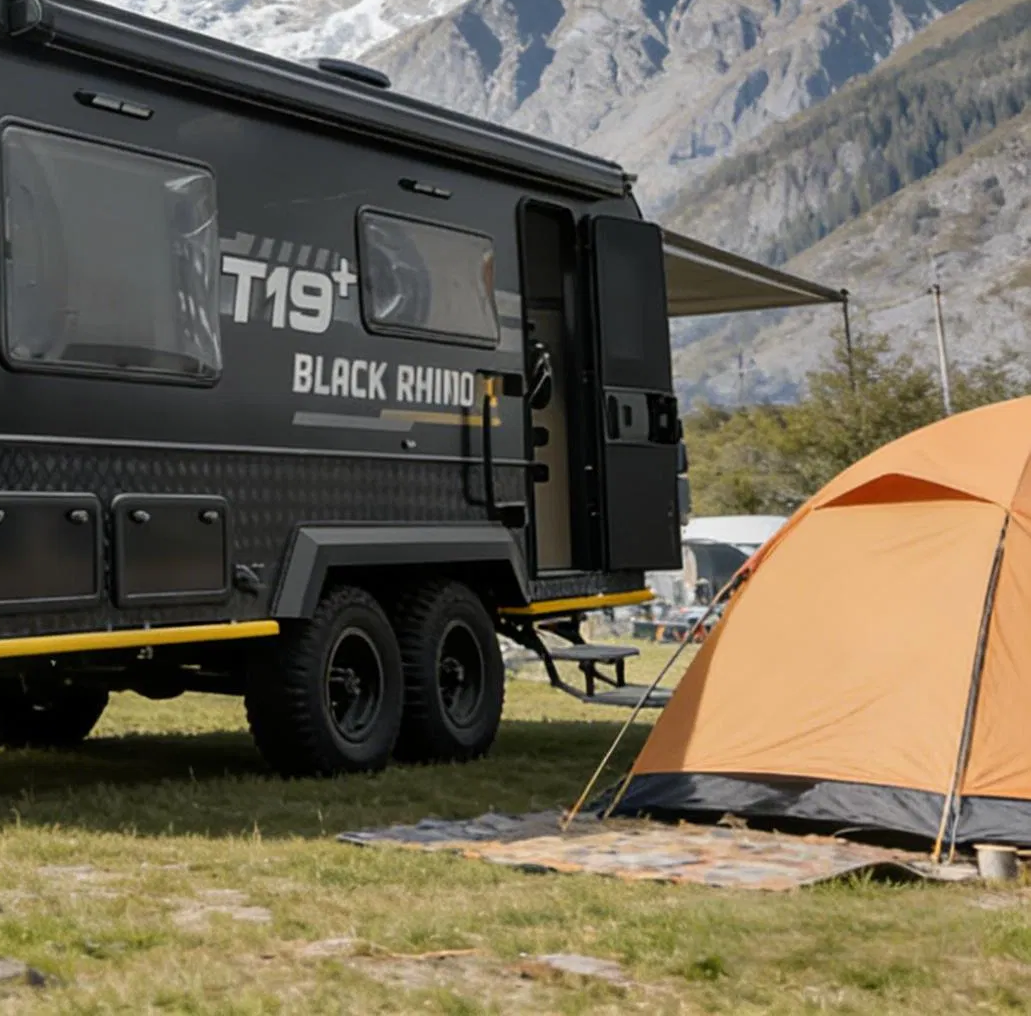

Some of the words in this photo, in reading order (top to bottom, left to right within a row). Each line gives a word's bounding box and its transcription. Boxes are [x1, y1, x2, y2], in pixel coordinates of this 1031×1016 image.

[222, 255, 358, 334] T19+
[292, 353, 388, 401] BLACK
[396, 364, 475, 407] RHINO
